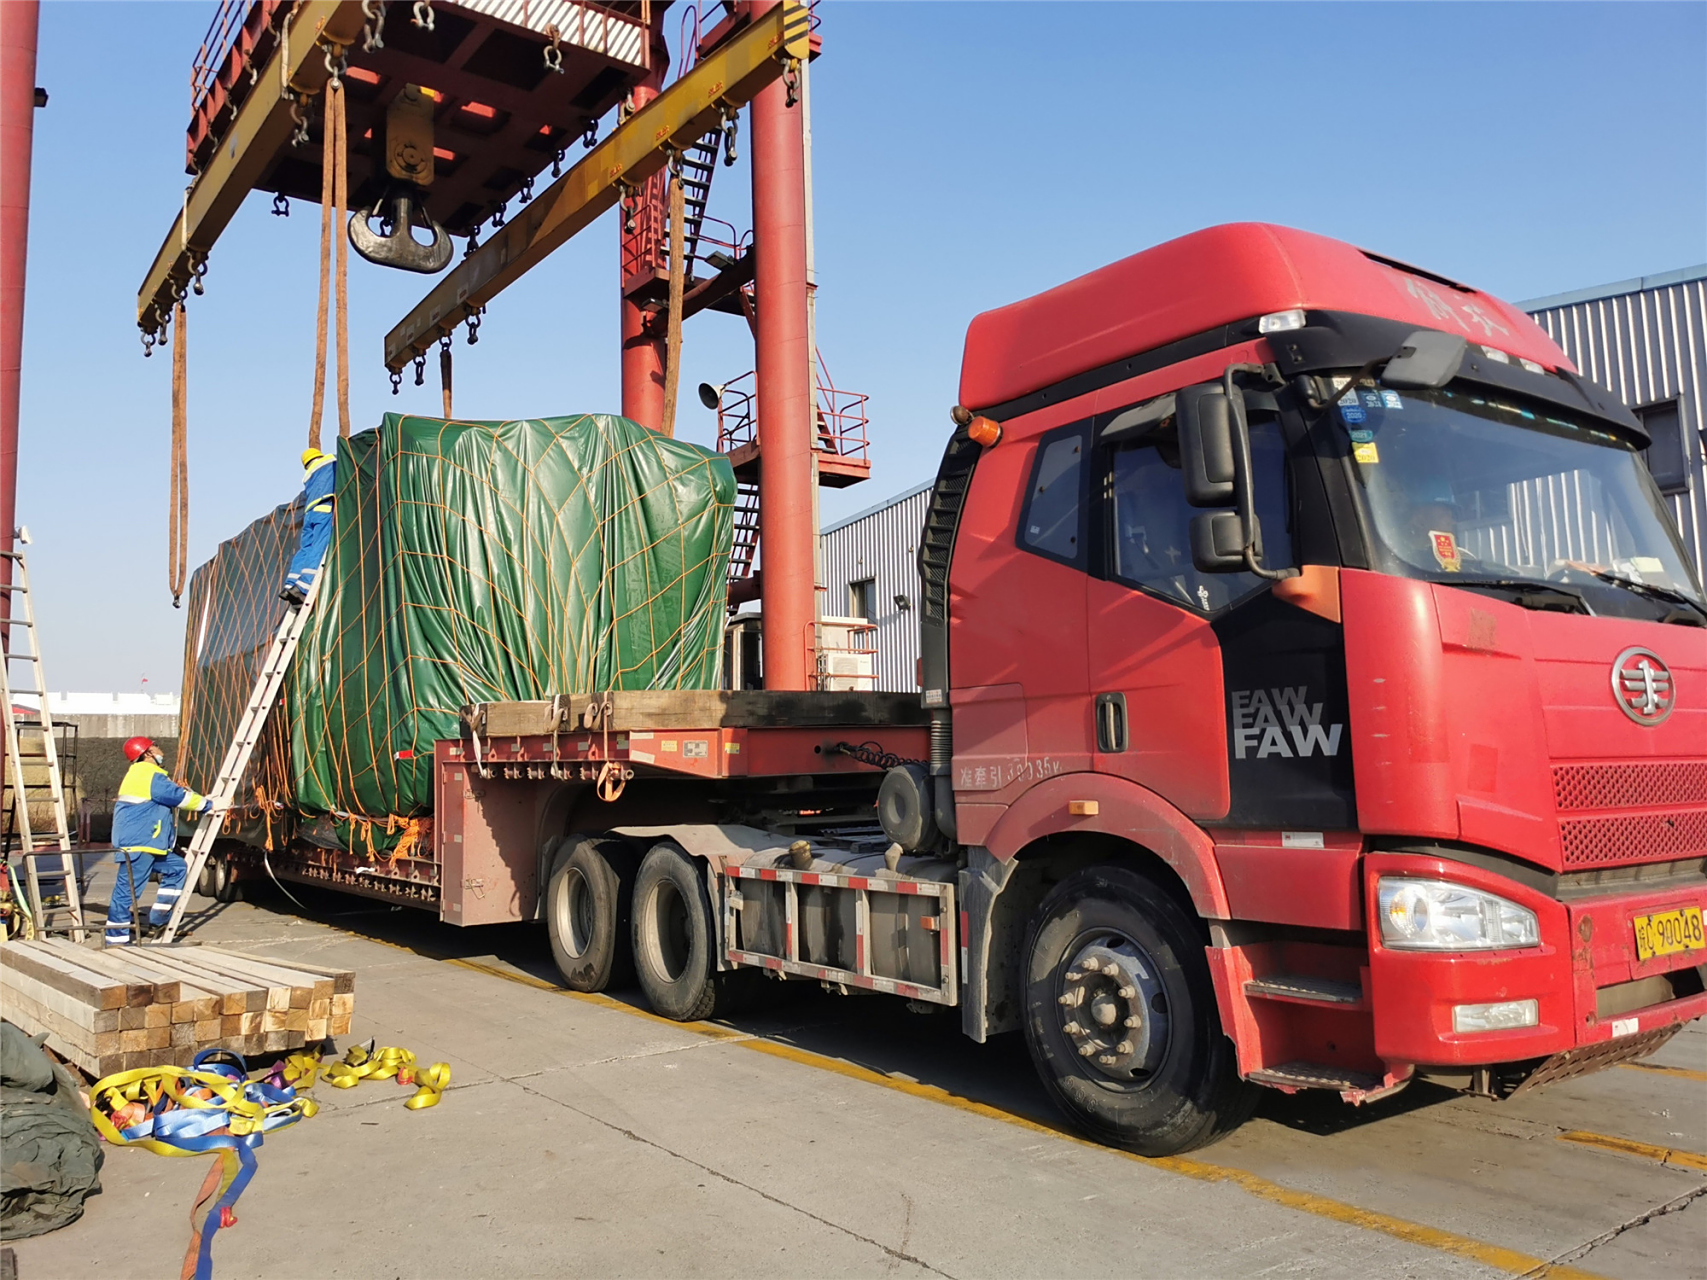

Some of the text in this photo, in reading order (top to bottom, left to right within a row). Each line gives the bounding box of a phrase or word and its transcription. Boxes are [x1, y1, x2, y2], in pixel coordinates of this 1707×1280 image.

[1232, 686, 1308, 711] FAW
[1233, 703, 1324, 732] FAW
[1234, 724, 1343, 759] FAW
